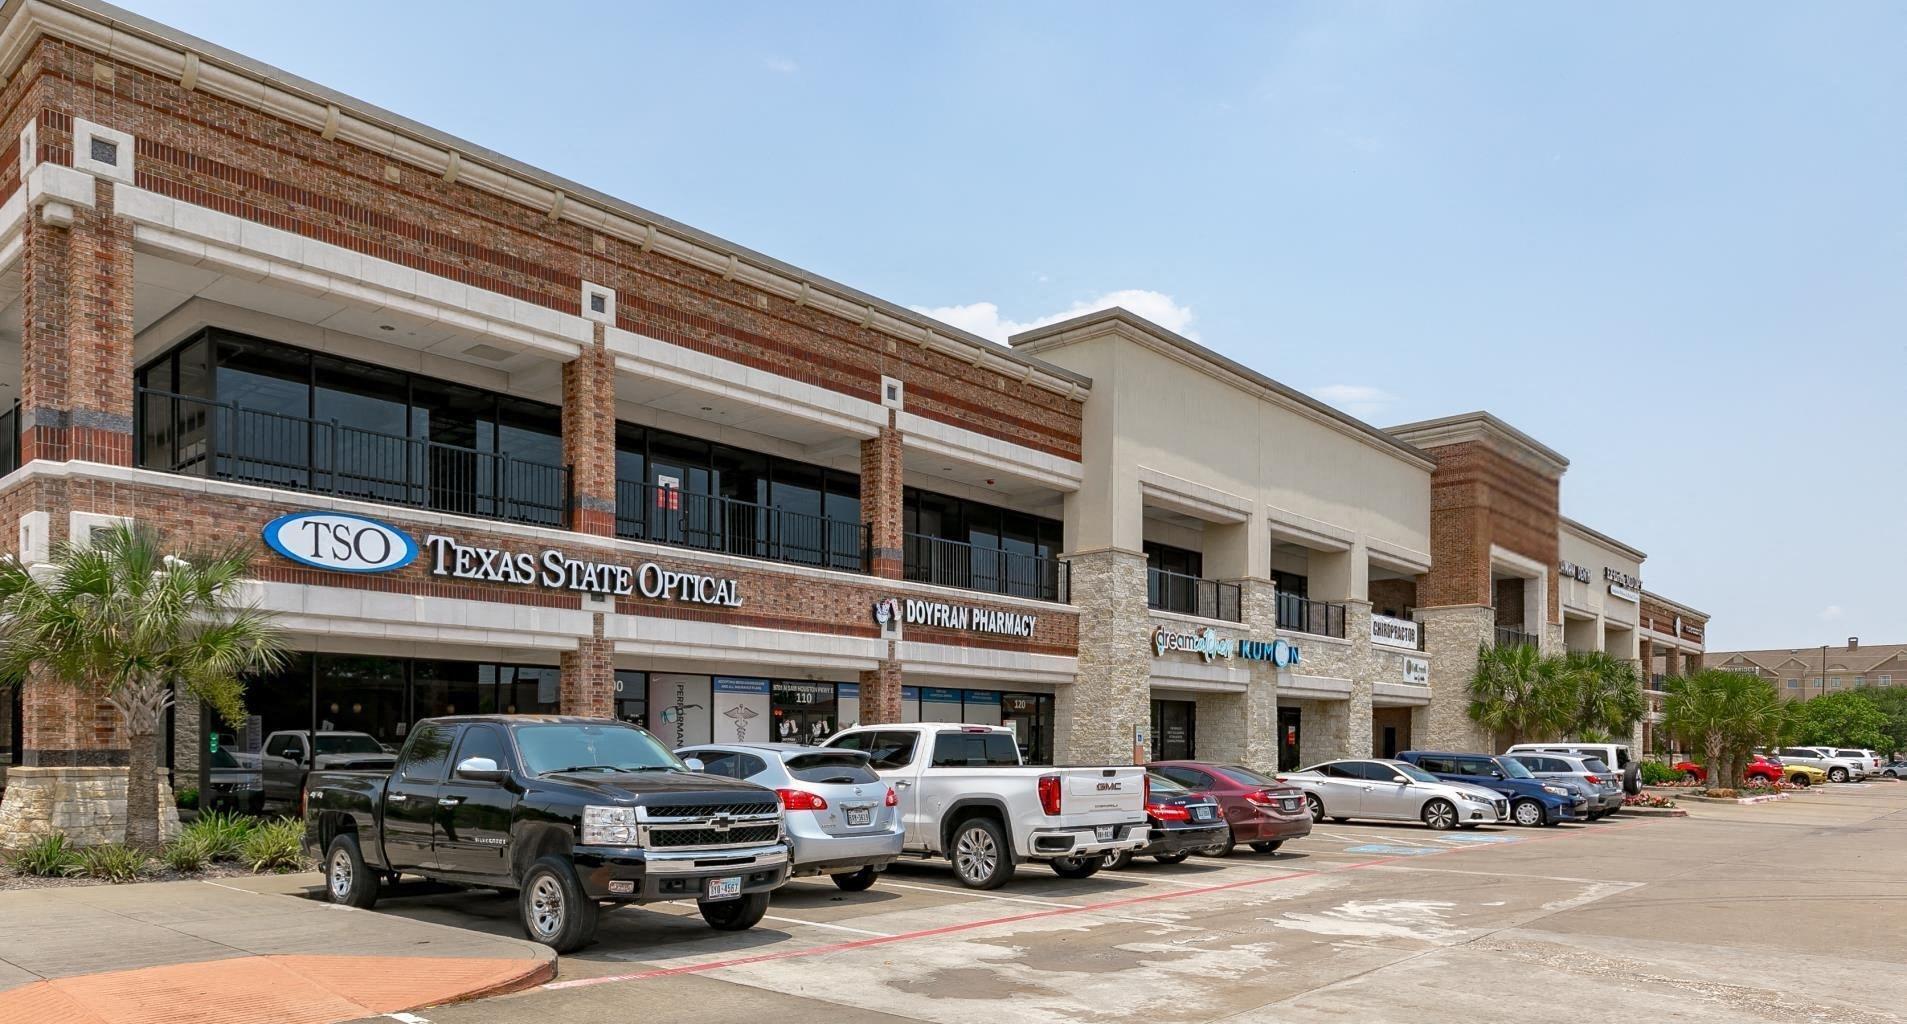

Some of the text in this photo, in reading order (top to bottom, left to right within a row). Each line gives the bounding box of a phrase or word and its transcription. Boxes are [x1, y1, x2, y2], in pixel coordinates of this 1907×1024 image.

[301, 521, 391, 564] TSO
[425, 534, 744, 607] TEXAS STATE OPTICAL
[906, 599, 1037, 637] DOYFRAN PHARMACY
[1372, 621, 1416, 642] CHIROPRACTOR
[1241, 639, 1300, 668] KUMON
[796, 693, 812, 703] 110
[1014, 699, 1026, 710] 120
[1096, 782, 1121, 791] GMC
